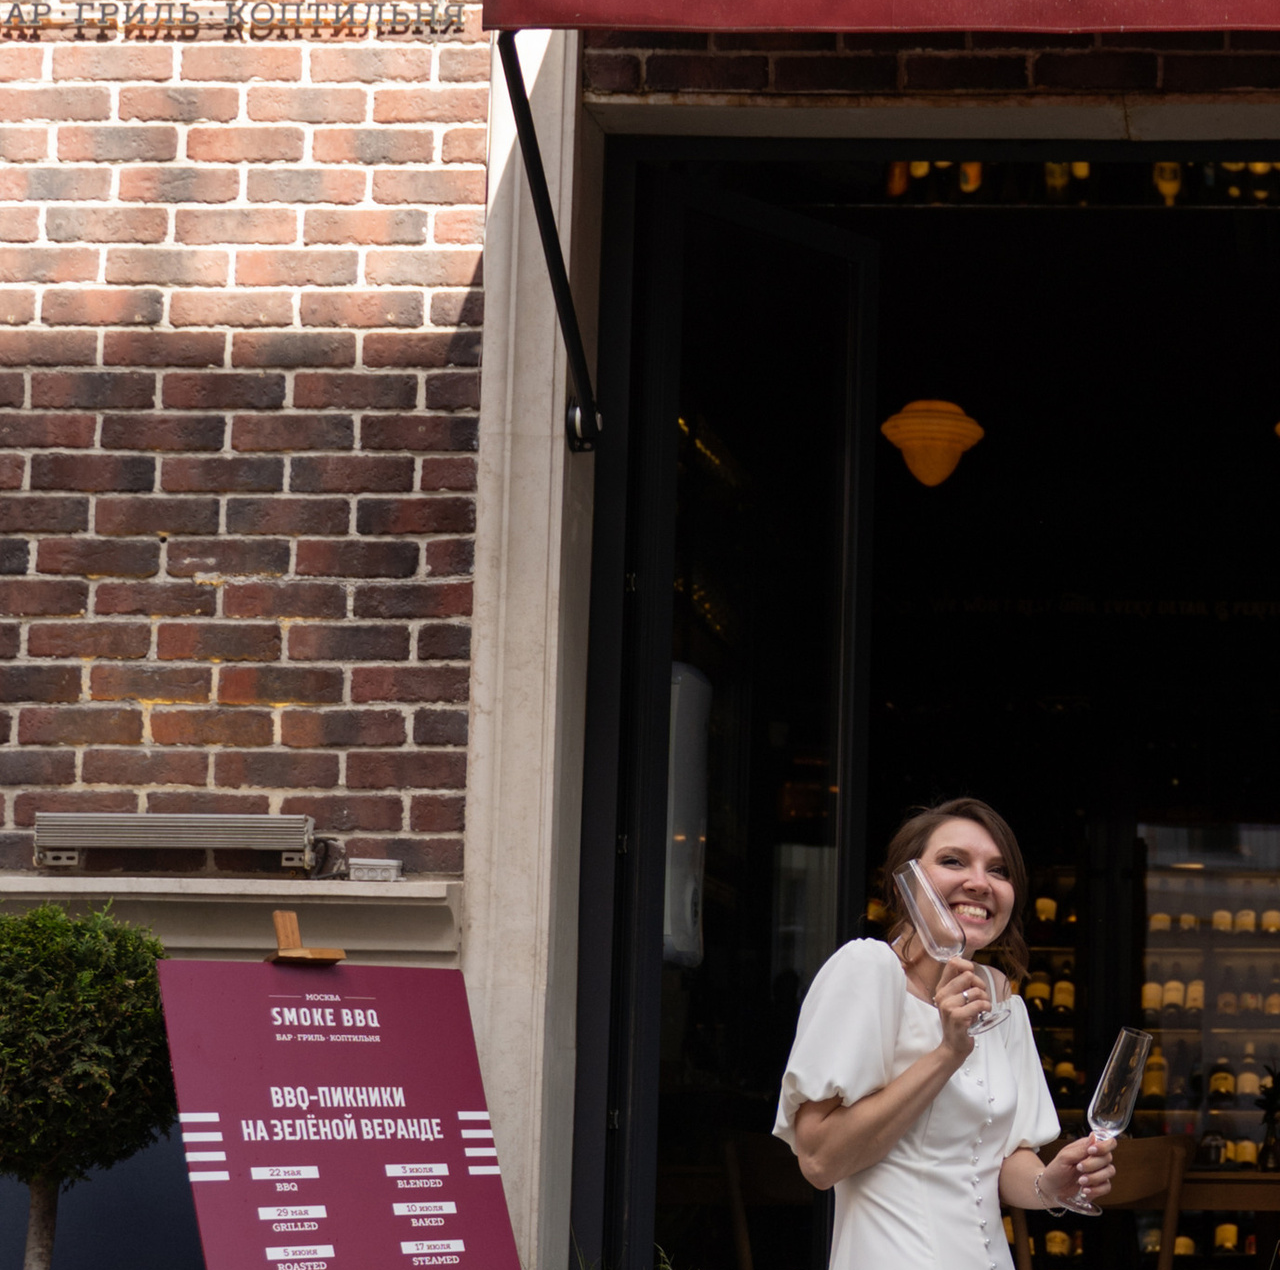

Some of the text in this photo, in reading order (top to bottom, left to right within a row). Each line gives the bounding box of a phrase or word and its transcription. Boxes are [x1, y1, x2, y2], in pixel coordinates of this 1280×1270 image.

[74, 2, 200, 25] ГРИЛЬ
[223, 1, 465, 26] КОПТИЛЬНЯ
[271, 1007, 380, 1027] SMOKE BBQ
[297, 1034, 325, 1042] ГРИЛЬ
[330, 1034, 381, 1042] КОПТИЛЬНЯ
[270, 1086, 406, 1110] BBQ-ПИКНИКИ
[241, 1113, 444, 1142] НА ЗЕЛЁНОЙ ВЕРАНДЕ
[269, 1169, 281, 1177] 22
[401, 1166, 407, 1174] 3
[275, 1182, 298, 1191] BBQ
[397, 1179, 443, 1188] BLENDED
[276, 1208, 288, 1217] 29
[407, 1204, 417, 1212] 10
[411, 1217, 445, 1227] BAKED
[272, 1222, 318, 1232] GRILLED
[283, 1249, 289, 1257] 5
[412, 1256, 460, 1266] STEAMED
